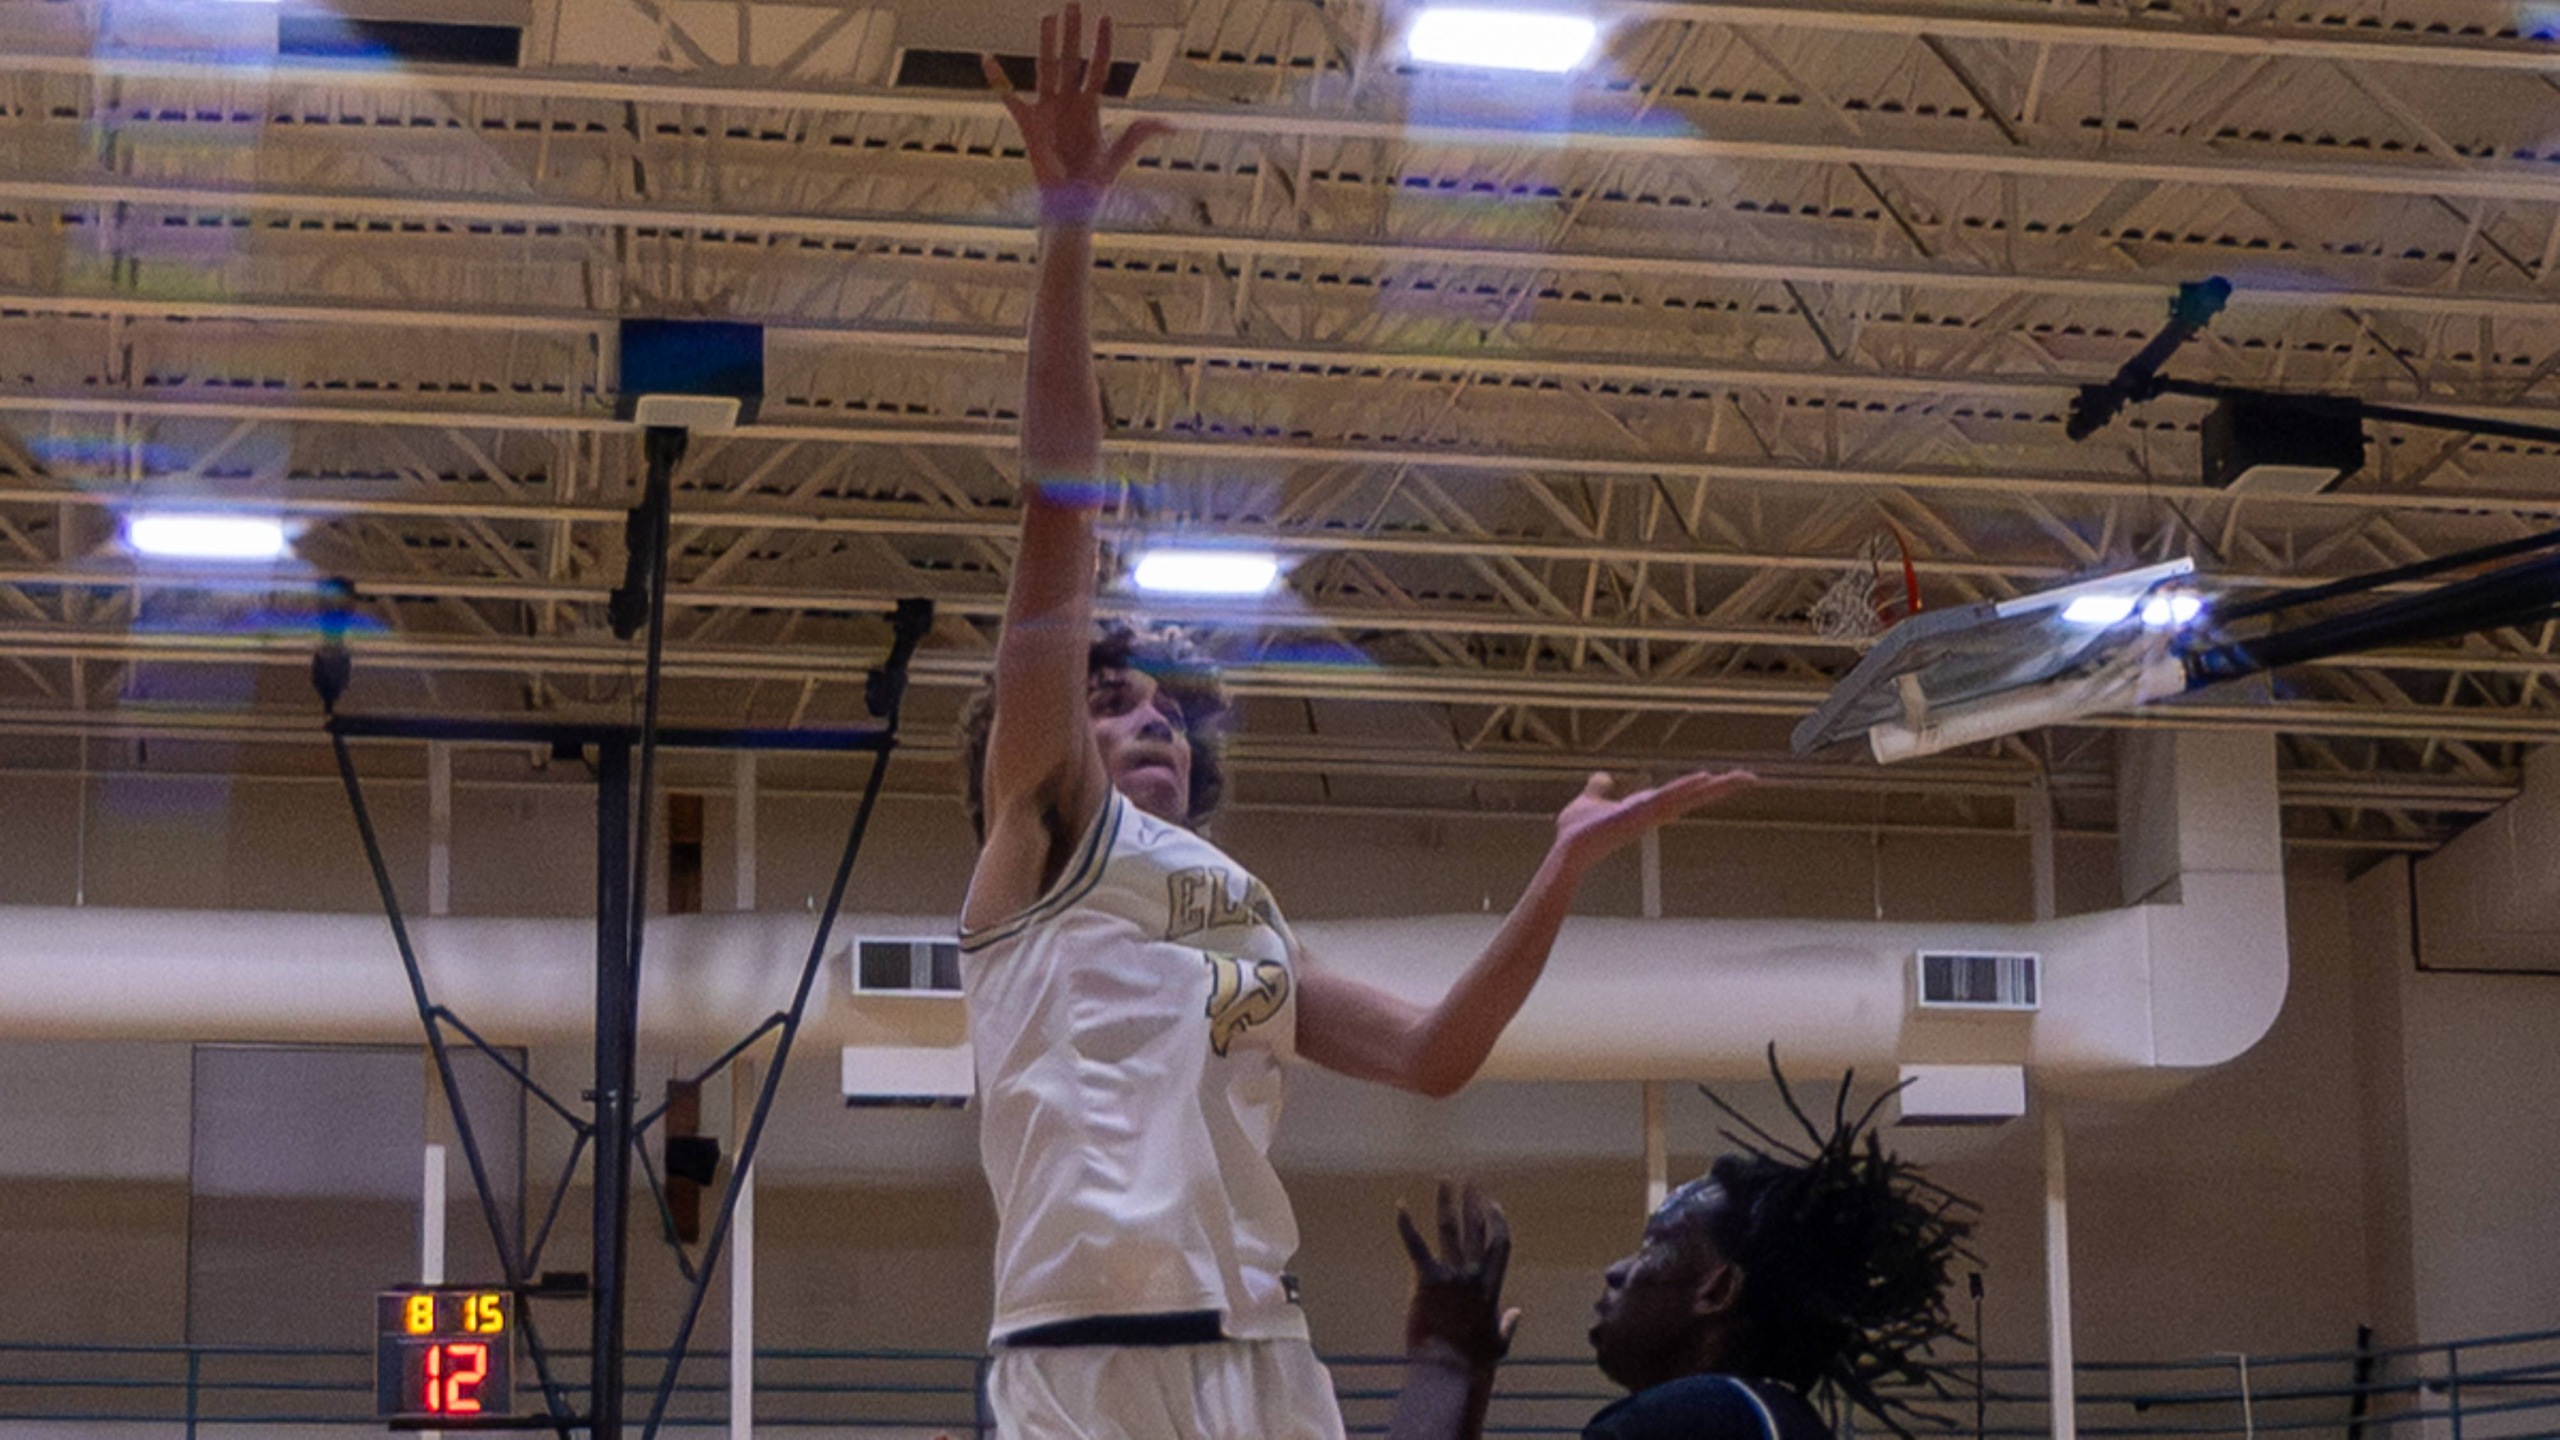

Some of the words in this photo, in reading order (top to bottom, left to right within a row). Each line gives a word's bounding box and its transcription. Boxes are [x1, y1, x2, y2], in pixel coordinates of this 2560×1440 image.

[405, 1294, 434, 1335] 8
[463, 1294, 504, 1333] 15
[425, 1343, 487, 1416] 12
